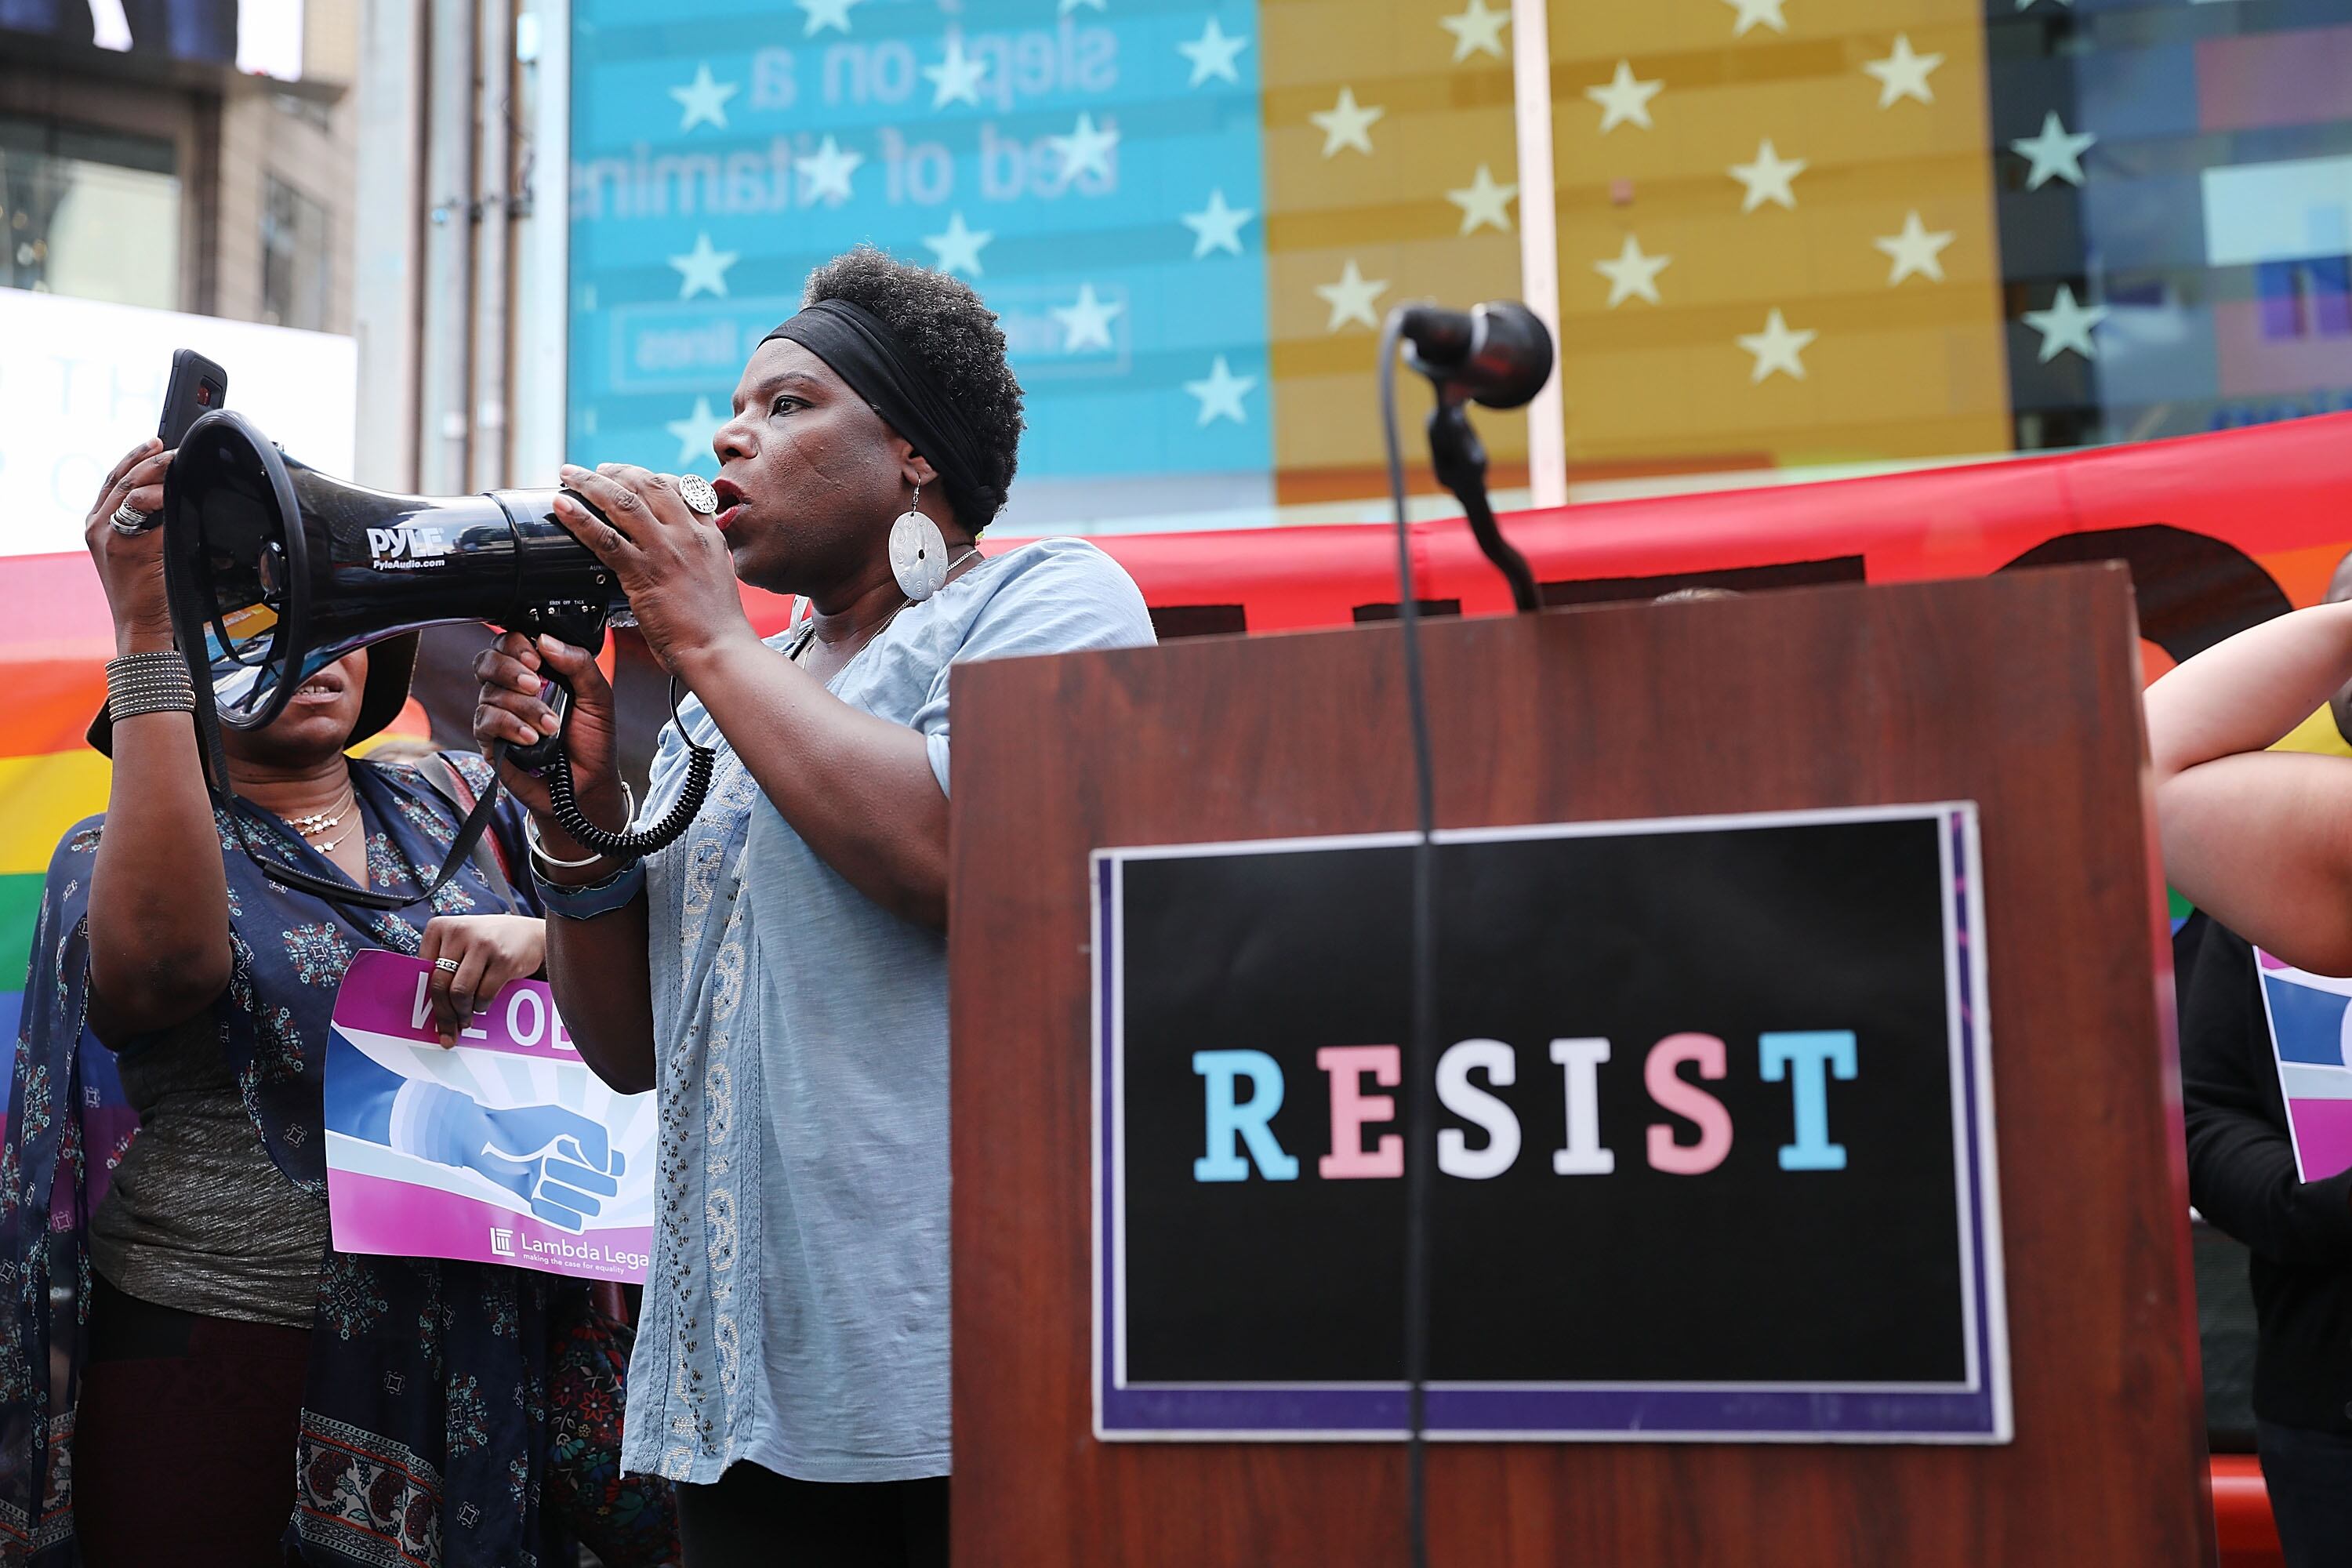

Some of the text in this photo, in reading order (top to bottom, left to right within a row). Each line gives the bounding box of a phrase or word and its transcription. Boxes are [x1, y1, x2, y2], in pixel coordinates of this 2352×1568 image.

[366, 528, 444, 558] PYLE
[373, 559, 445, 571] PyleAudio.com
[1192, 1029, 1858, 1181] RESIST
[521, 1233, 651, 1270] Lambda Lega
[523, 1254, 550, 1265] making
[550, 1258, 563, 1266] the
[583, 1261, 593, 1270] for
[595, 1265, 625, 1276] equality
